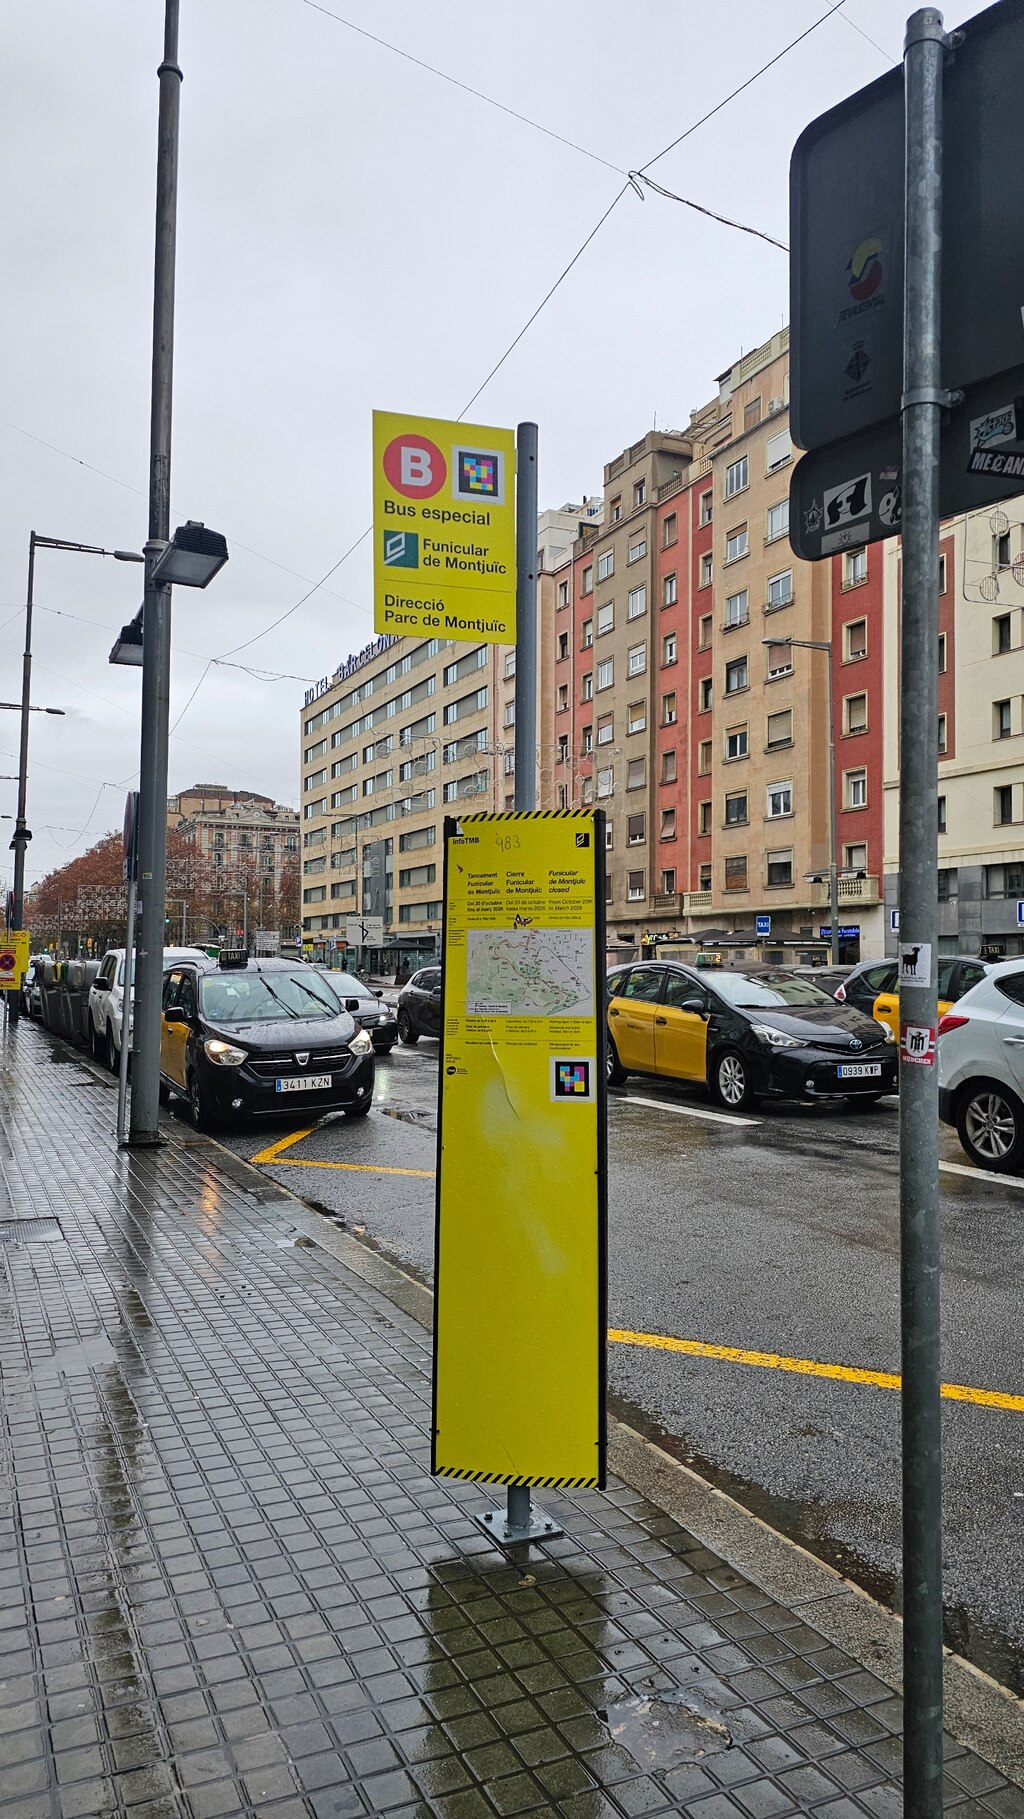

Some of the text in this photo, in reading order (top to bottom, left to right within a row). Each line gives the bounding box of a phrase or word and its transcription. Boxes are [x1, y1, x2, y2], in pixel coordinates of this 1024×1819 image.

[400, 446, 433, 487] B
[384, 500, 491, 526] Bus especial
[423, 538, 489, 557] Funicular
[423, 554, 507, 574] de Montjuïc
[384, 594, 445, 611] Direcció
[384, 610, 507, 633] Parc de Montjuïc
[304, 676, 331, 706] HOTEL
[452, 837, 480, 845] InfoTMB
[227, 951, 241, 960] TAXI
[842, 1066, 863, 1076] 0939
[283, 1077, 330, 1090] 3411 KZN
